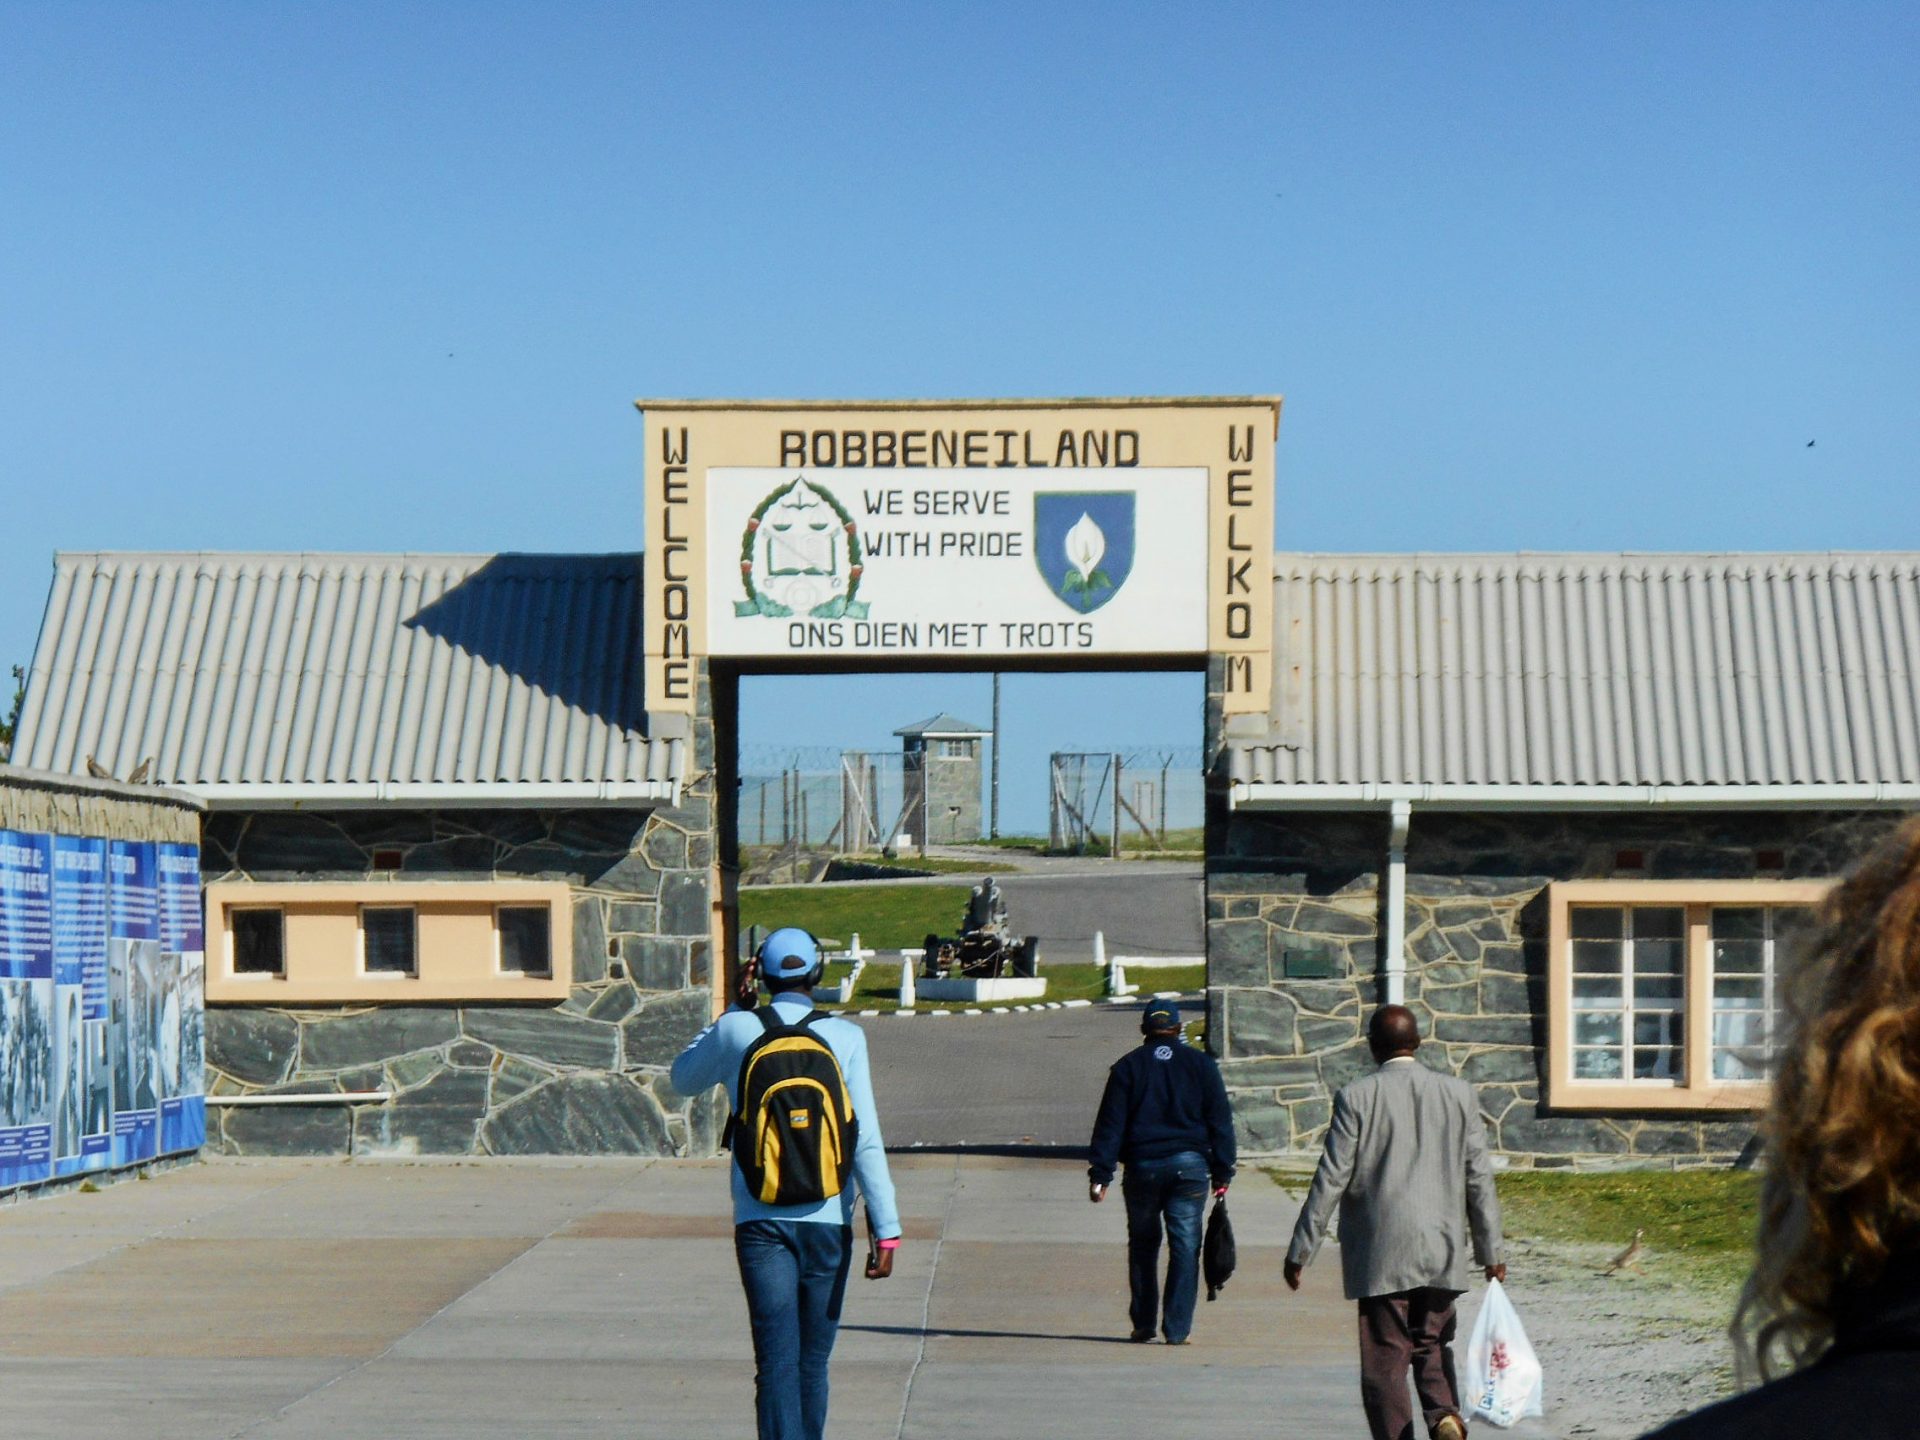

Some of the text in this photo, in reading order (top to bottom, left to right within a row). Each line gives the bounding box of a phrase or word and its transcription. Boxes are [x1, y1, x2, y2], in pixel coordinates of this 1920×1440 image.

[780, 429, 1140, 469] ROBBENEILAND
[864, 489, 1011, 515] WE SERVE
[864, 532, 1023, 557] WITH PRIDE
[1226, 423, 1255, 693] WELKOM
[662, 426, 689, 699] WELCOME
[788, 622, 1094, 648] ONS DIEN MET TROTS
